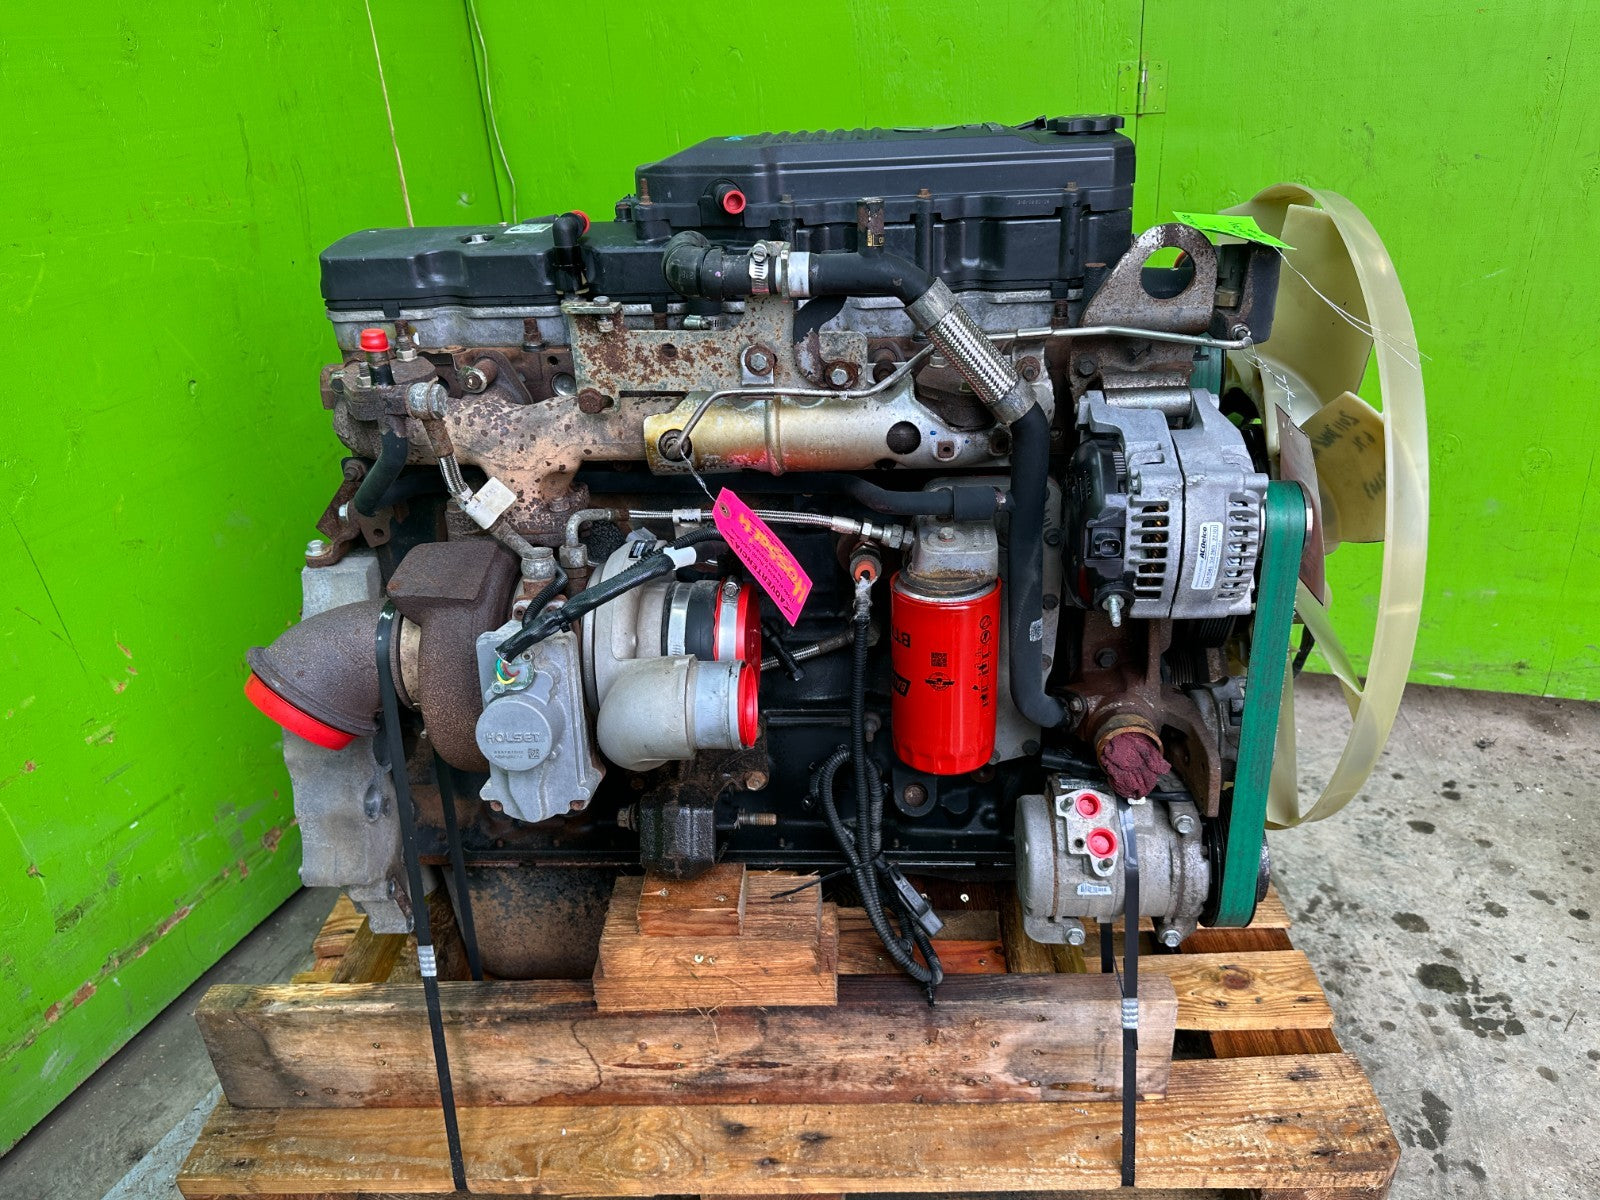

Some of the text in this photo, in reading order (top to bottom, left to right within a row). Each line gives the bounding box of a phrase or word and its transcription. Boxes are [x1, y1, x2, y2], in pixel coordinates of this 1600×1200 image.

[1200, 527, 1208, 559] ACDelco
[733, 541, 787, 603] ADVERTENCIA
[485, 732, 540, 745] HOLSET
